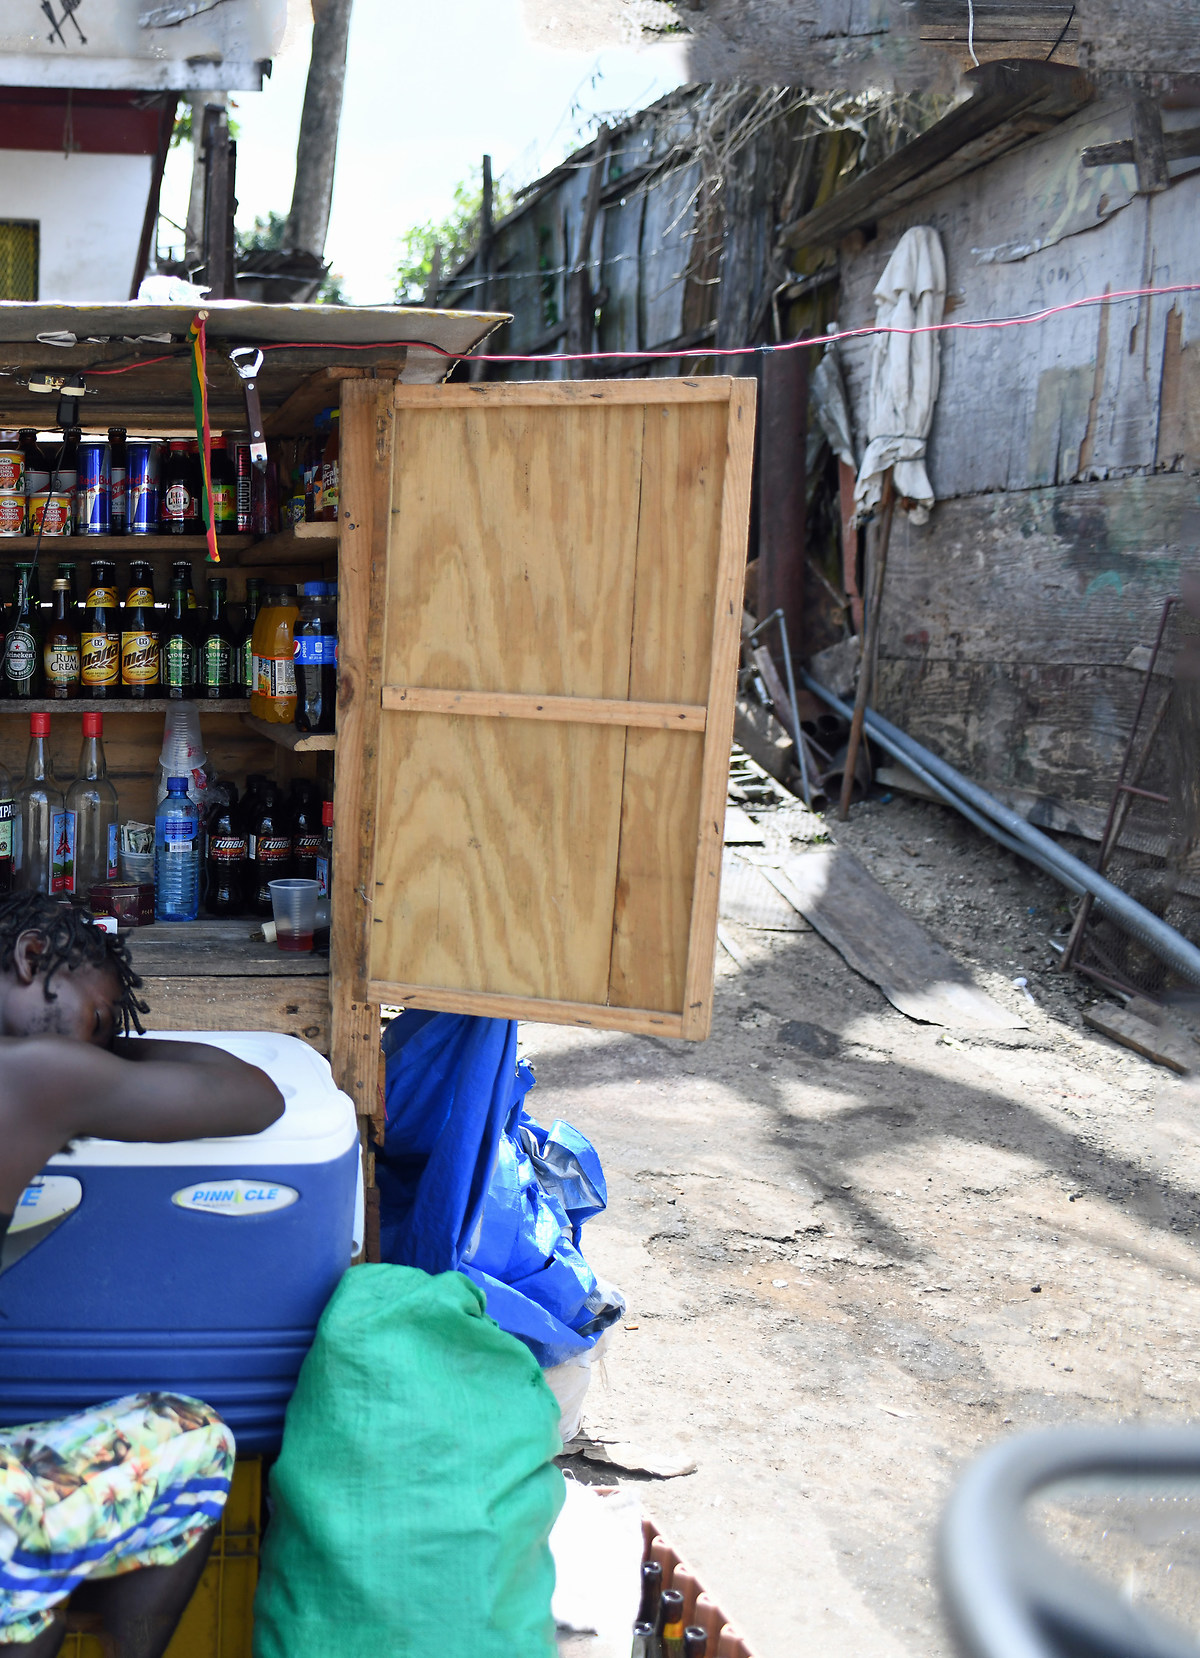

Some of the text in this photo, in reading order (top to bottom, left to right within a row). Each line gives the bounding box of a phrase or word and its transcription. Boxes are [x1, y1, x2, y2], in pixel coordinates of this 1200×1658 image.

[56, 653, 77, 663] RUM
[215, 840, 244, 849] TURBO
[299, 838, 320, 846] TURB
